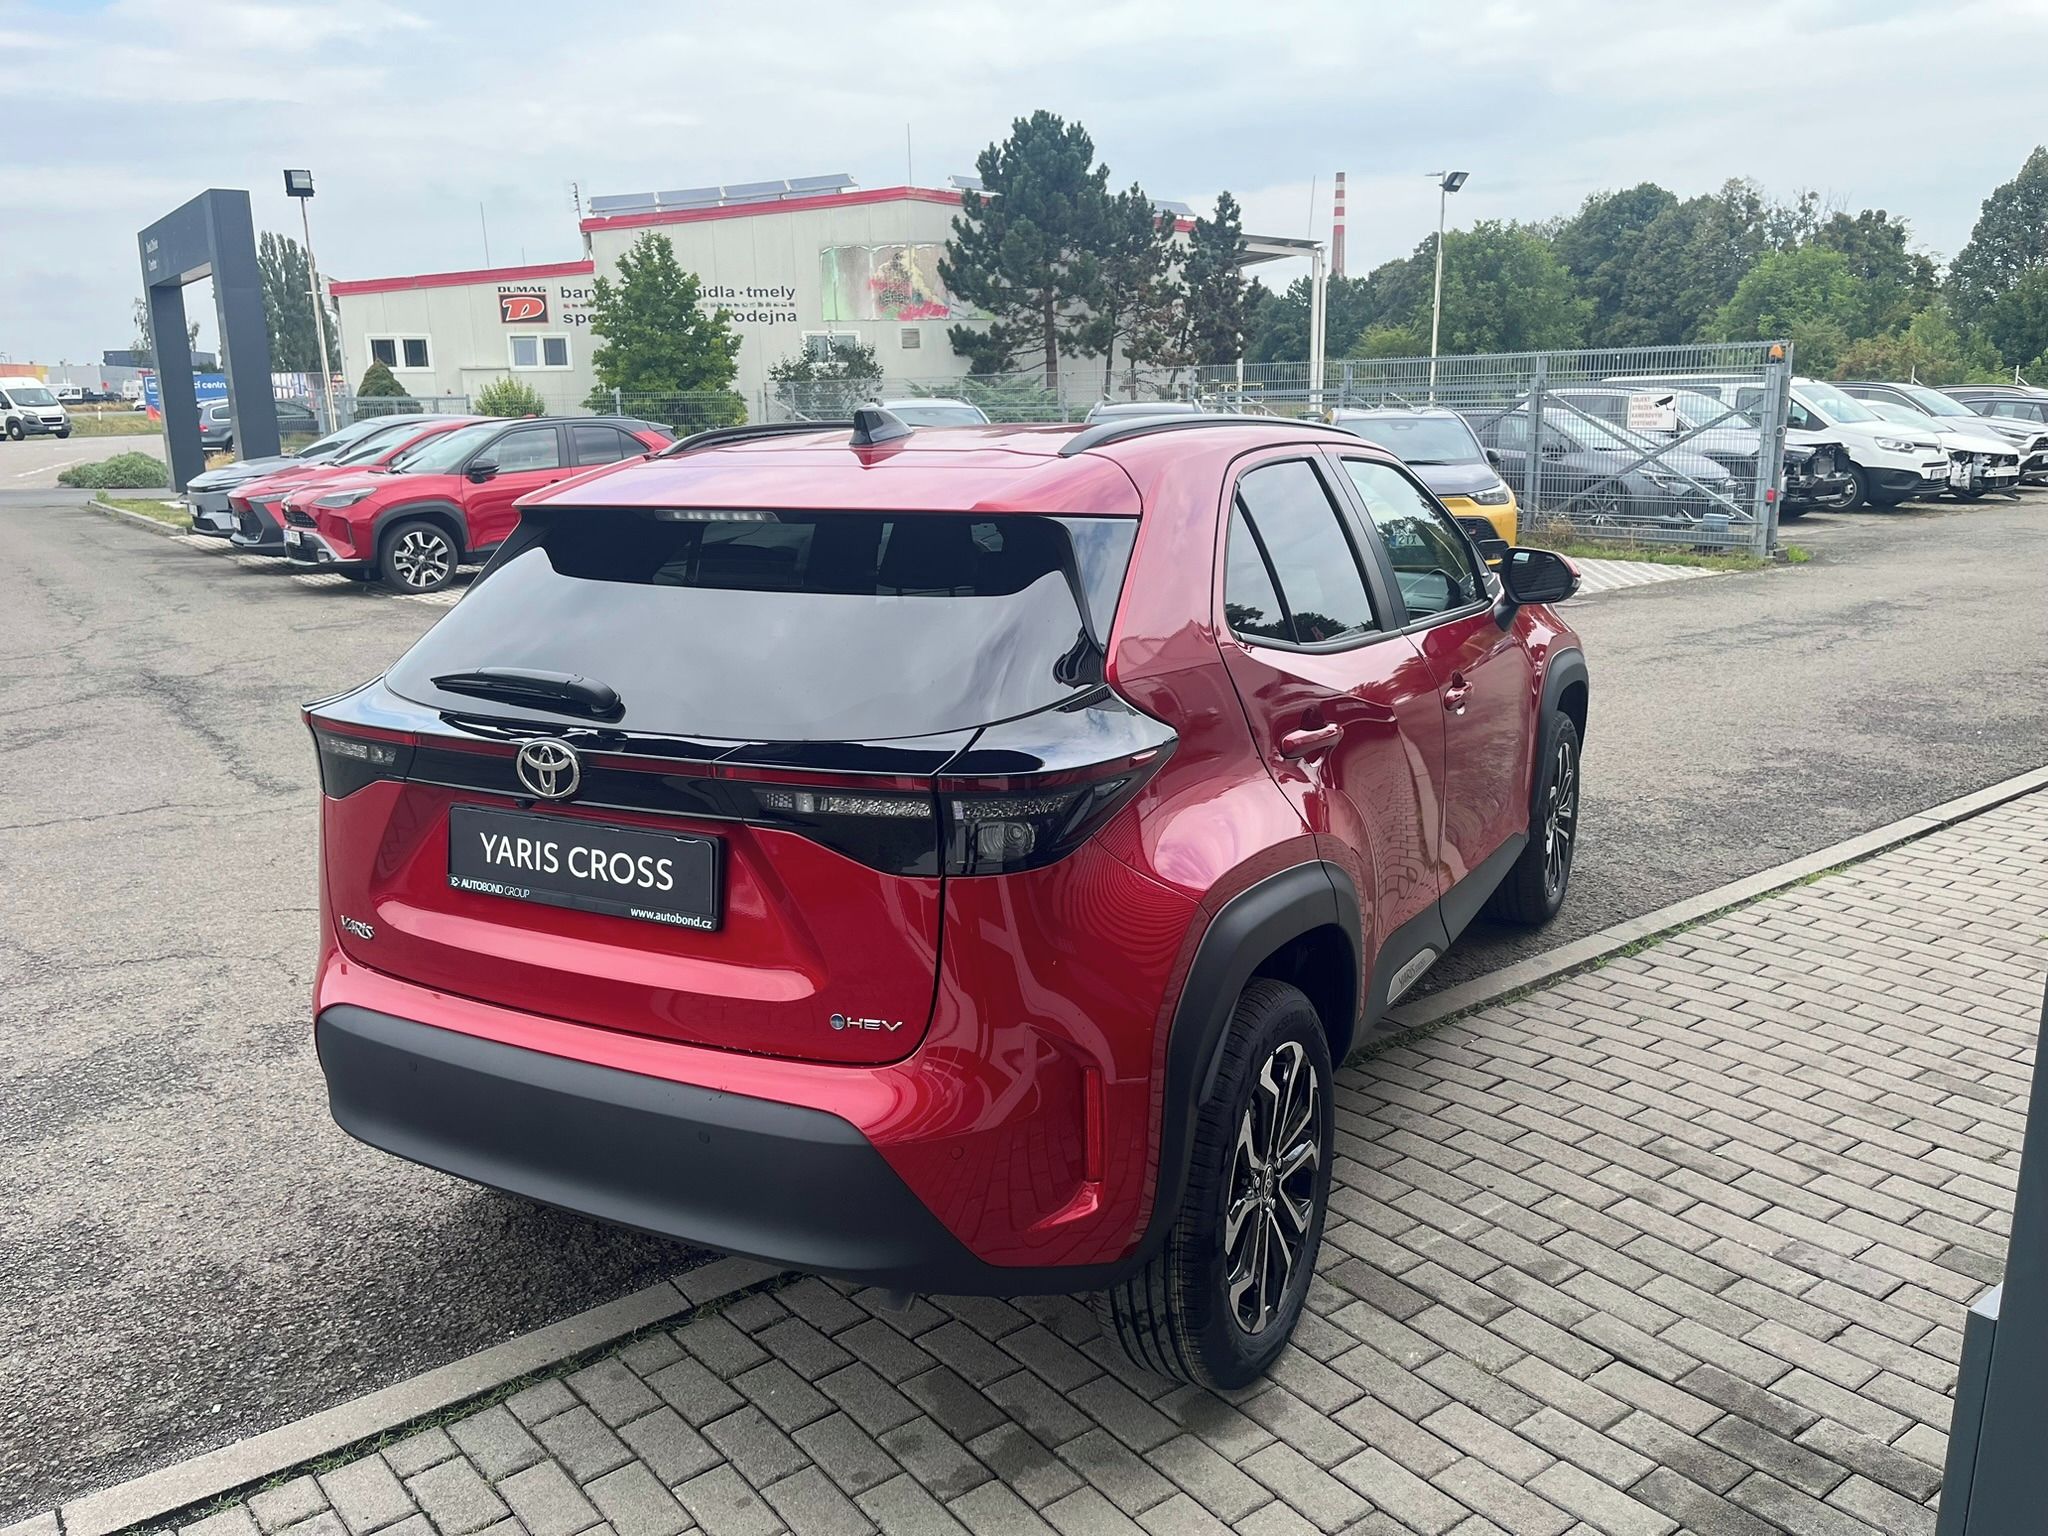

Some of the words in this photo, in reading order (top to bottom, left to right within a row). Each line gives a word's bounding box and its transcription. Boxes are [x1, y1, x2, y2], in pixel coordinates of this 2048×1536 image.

[746, 286, 796, 300] tmely
[728, 310, 797, 326] odejna
[479, 832, 560, 874] YARIS
[567, 846, 674, 891] CROSS
[461, 879, 503, 894] AUTOBOND
[504, 885, 530, 898] GROUP
[630, 906, 712, 929] www.autobond.cz
[846, 1016, 903, 1032] HEV
